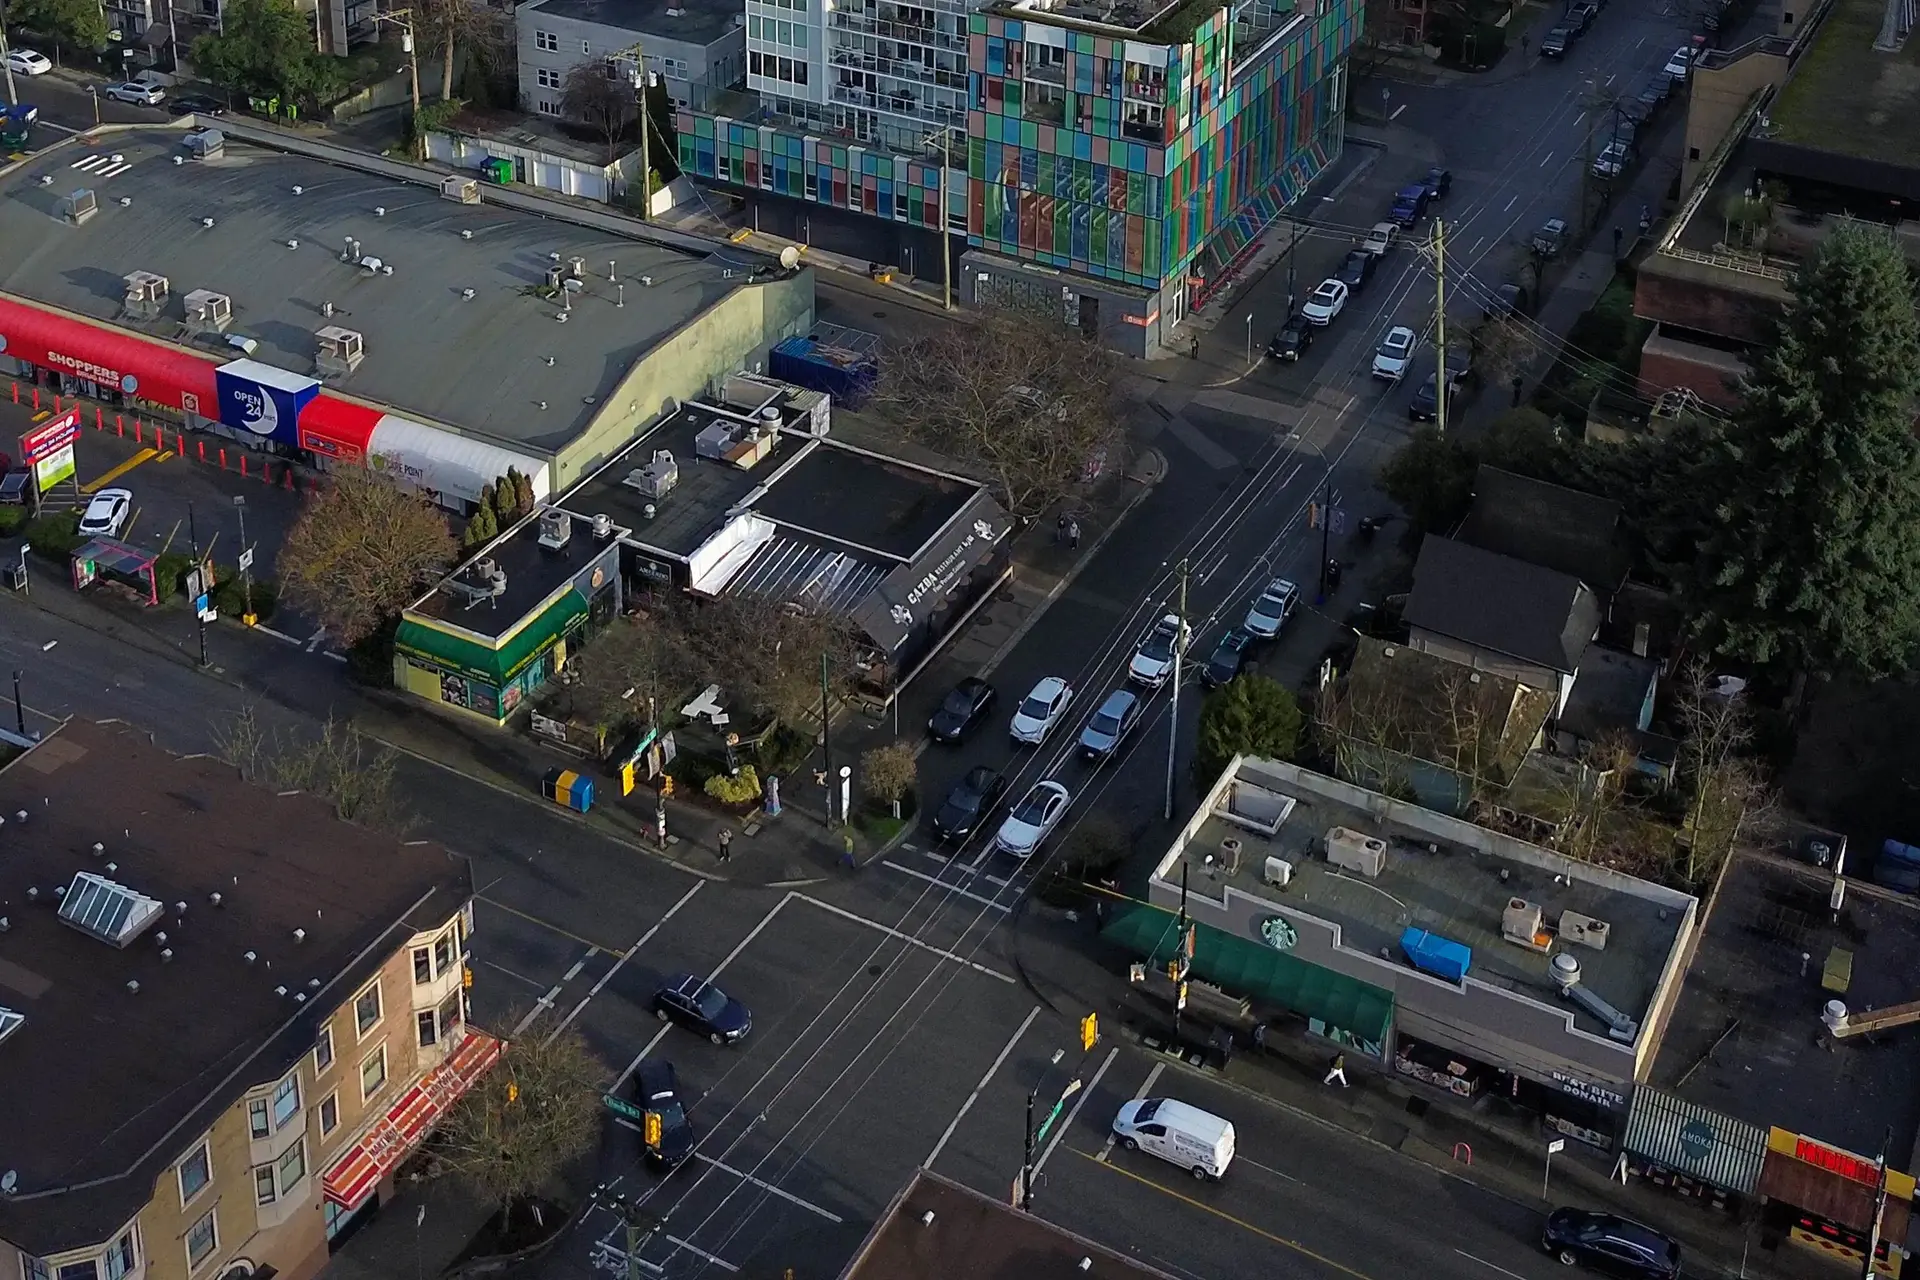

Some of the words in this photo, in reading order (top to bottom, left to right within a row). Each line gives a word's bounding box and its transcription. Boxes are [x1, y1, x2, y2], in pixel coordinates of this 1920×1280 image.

[47, 351, 120, 381] SHOPPERS
[98, 376, 120, 388] MART
[234, 391, 261, 405] OPEN
[245, 403, 261, 418] 24
[404, 464, 424, 478] POINT
[934, 545, 964, 575] RESTAURANT
[1552, 1072, 1588, 1090] BEST
[1591, 1086, 1624, 1105] BITE
[1563, 1084, 1611, 1108] DONAIR
